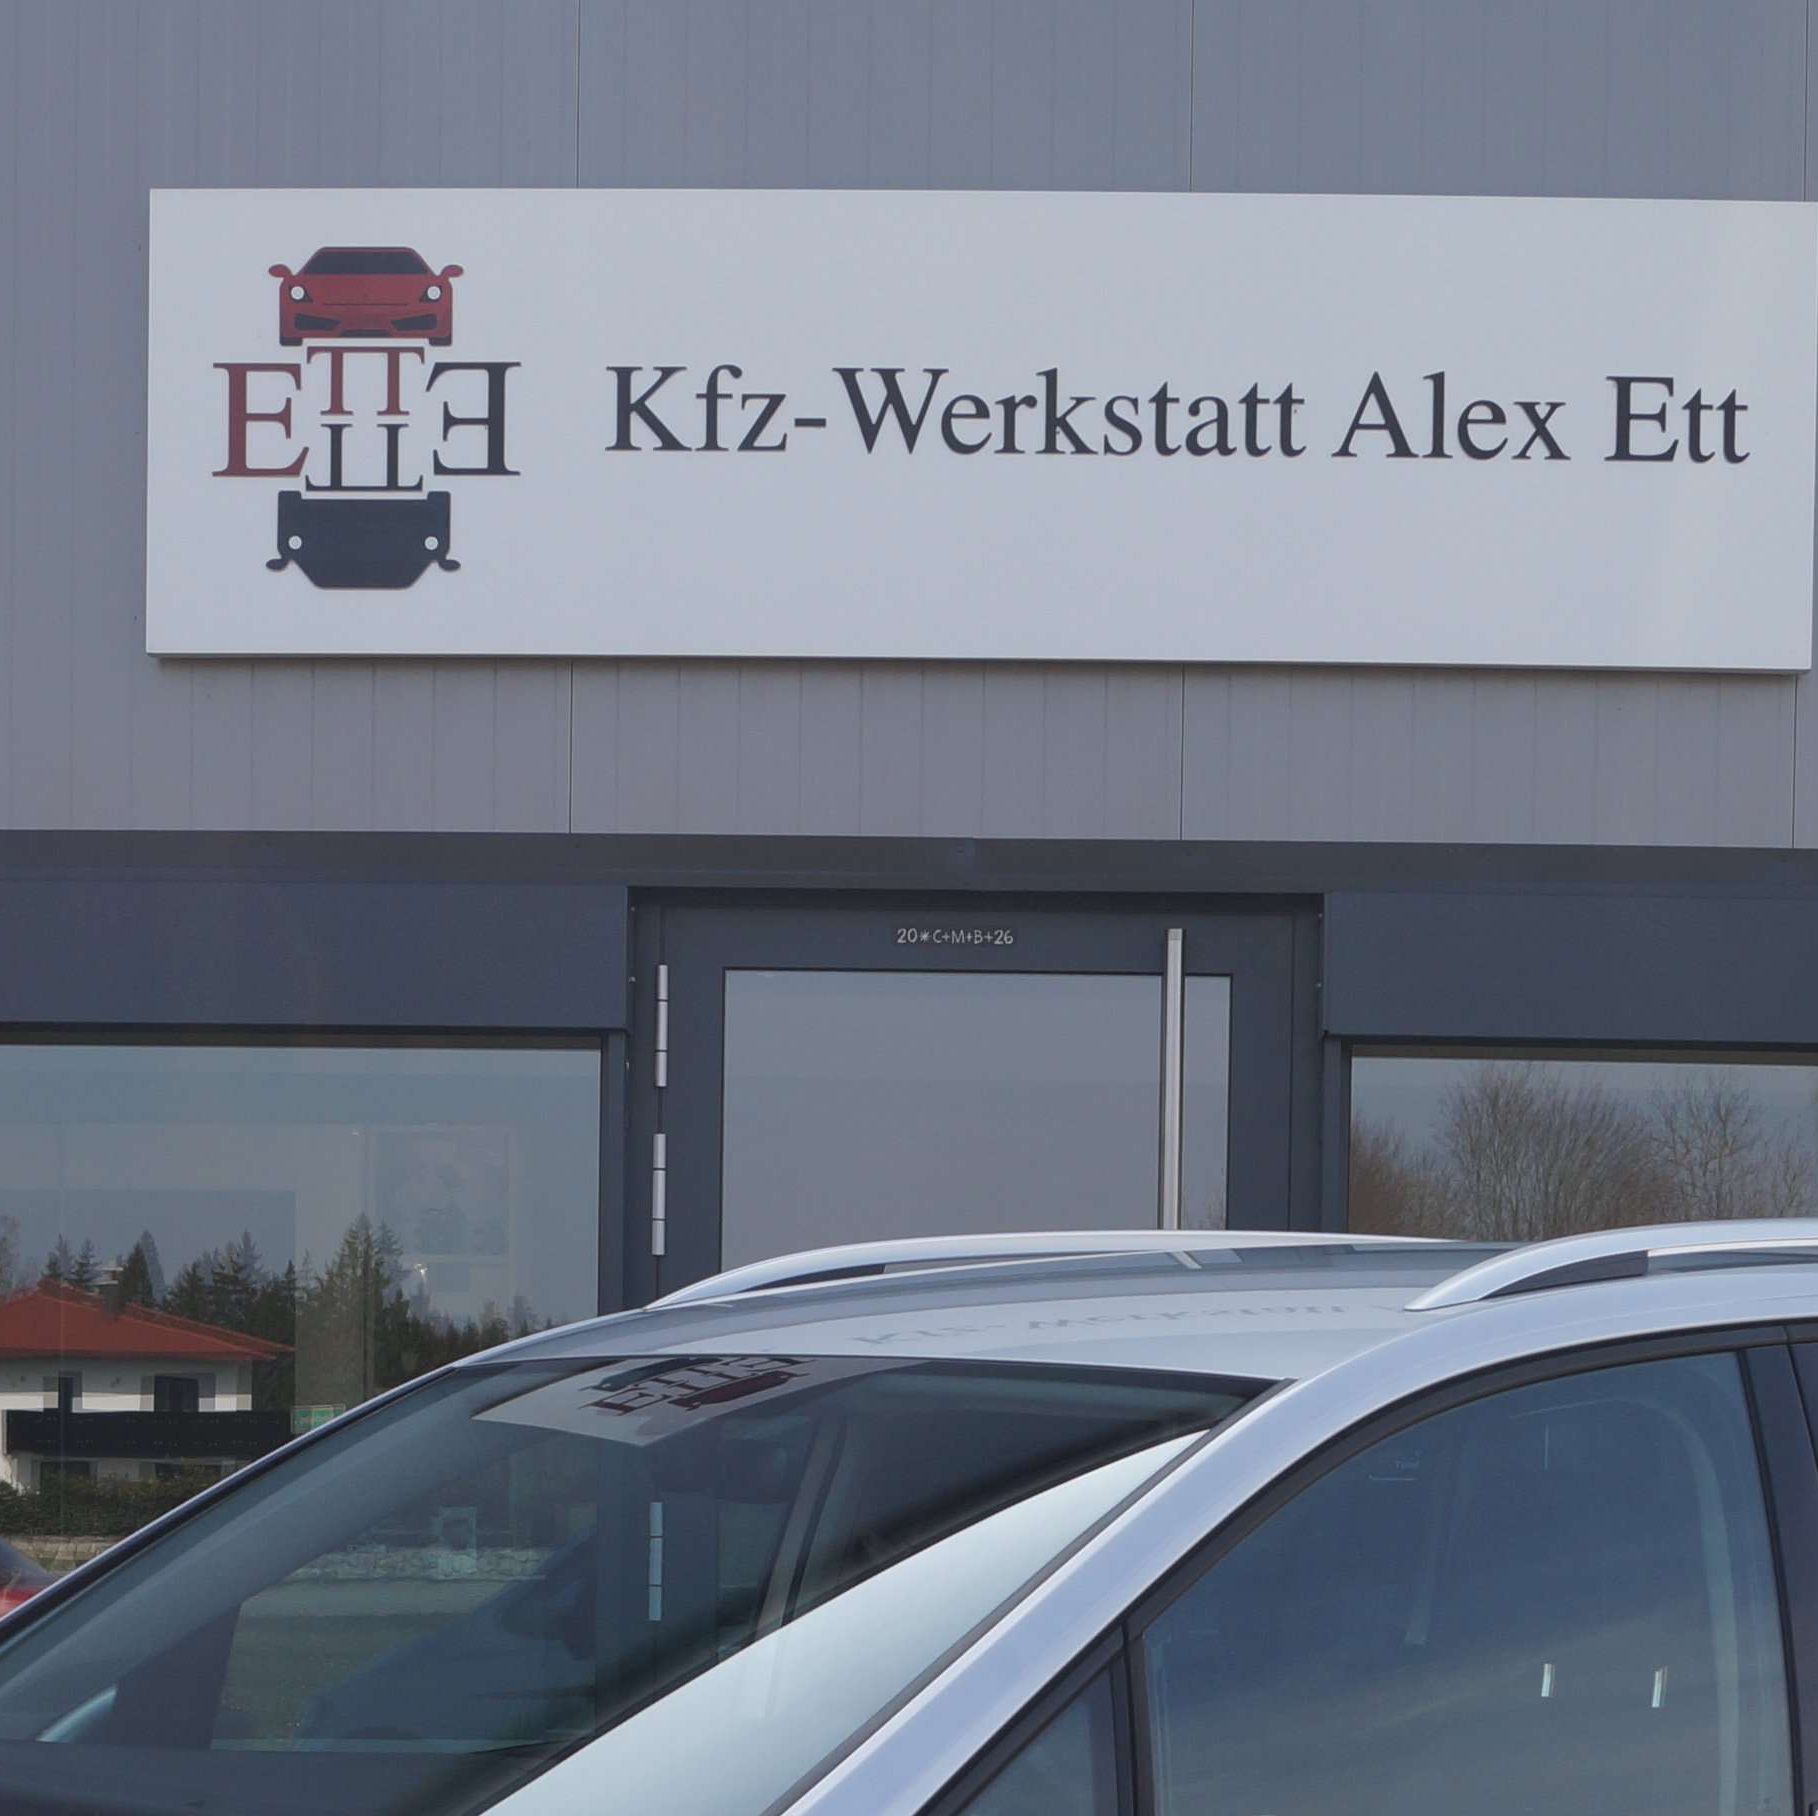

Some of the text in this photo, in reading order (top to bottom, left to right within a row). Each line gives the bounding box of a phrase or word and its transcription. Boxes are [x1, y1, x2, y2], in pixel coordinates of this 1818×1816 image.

[605, 364, 1750, 464] Kfz-Werkstatt Alex Ett
